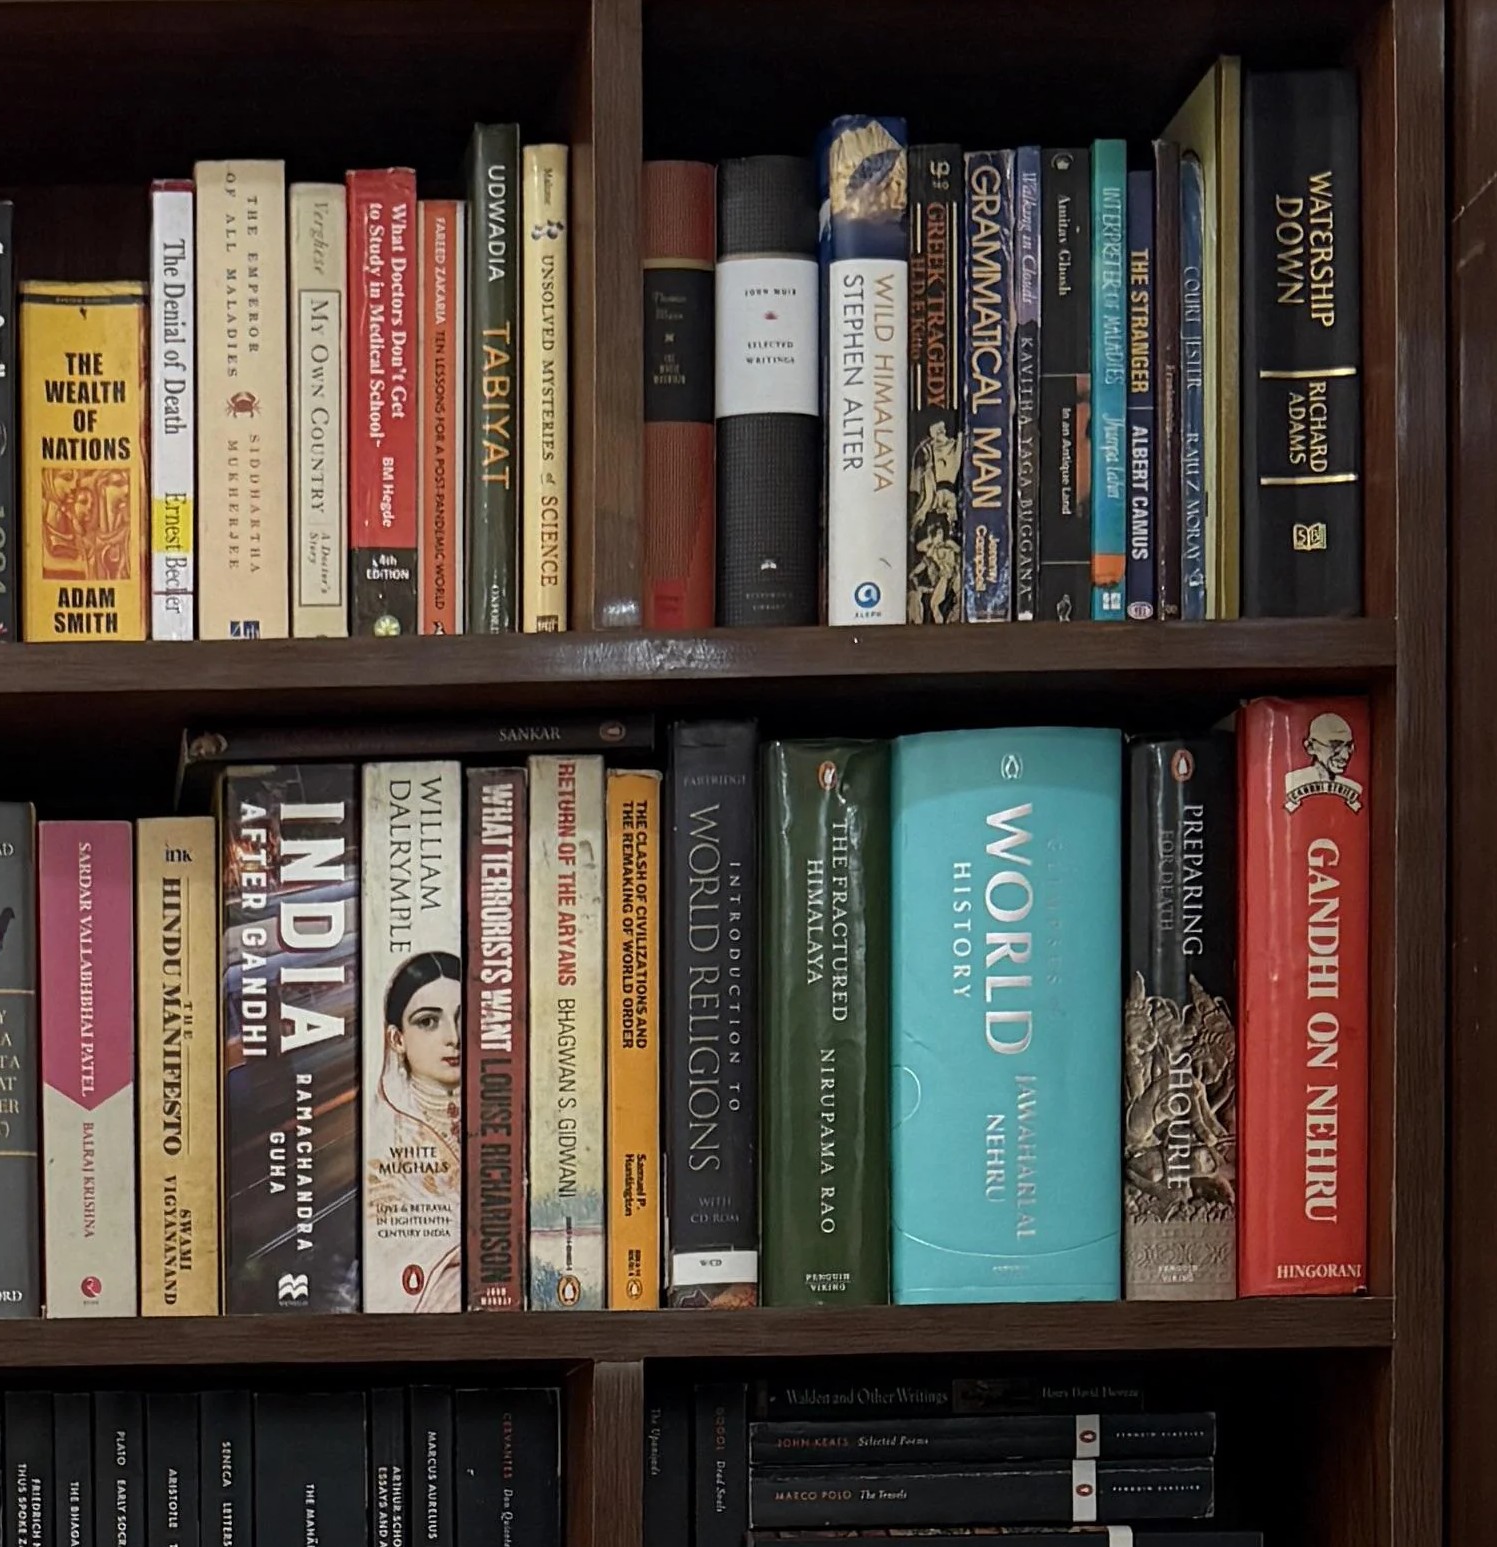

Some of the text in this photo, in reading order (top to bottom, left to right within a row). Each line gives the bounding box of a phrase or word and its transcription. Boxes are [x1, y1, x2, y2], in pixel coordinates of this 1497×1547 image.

[66, 352, 103, 376] THE
[843, 274, 863, 471] STEPHEN ALTER
[45, 380, 125, 404] WEALTH
[874, 274, 896, 494] WILD HIMALAYA
[73, 409, 97, 431] OF
[42, 437, 130, 461] NATIONS
[57, 588, 115, 608] ADAM
[55, 612, 118, 634] SMITH
[240, 803, 266, 1058] AFTER GANDHI
[280, 801, 345, 1051] INDIA
[953, 863, 970, 999] HISTORY
[985, 802, 1032, 1056] WORLD
[1306, 839, 1340, 1222] GANDHI ON NEHRU
[6, 1056, 20, 1071] A
[270, 1132, 285, 1194] GUHA
[297, 1075, 313, 1252] RAMACHANDRA
[390, 1146, 436, 1159] WHITE
[379, 1161, 448, 1176] MUGHALS
[1276, 1264, 1361, 1279] HINGORANI
